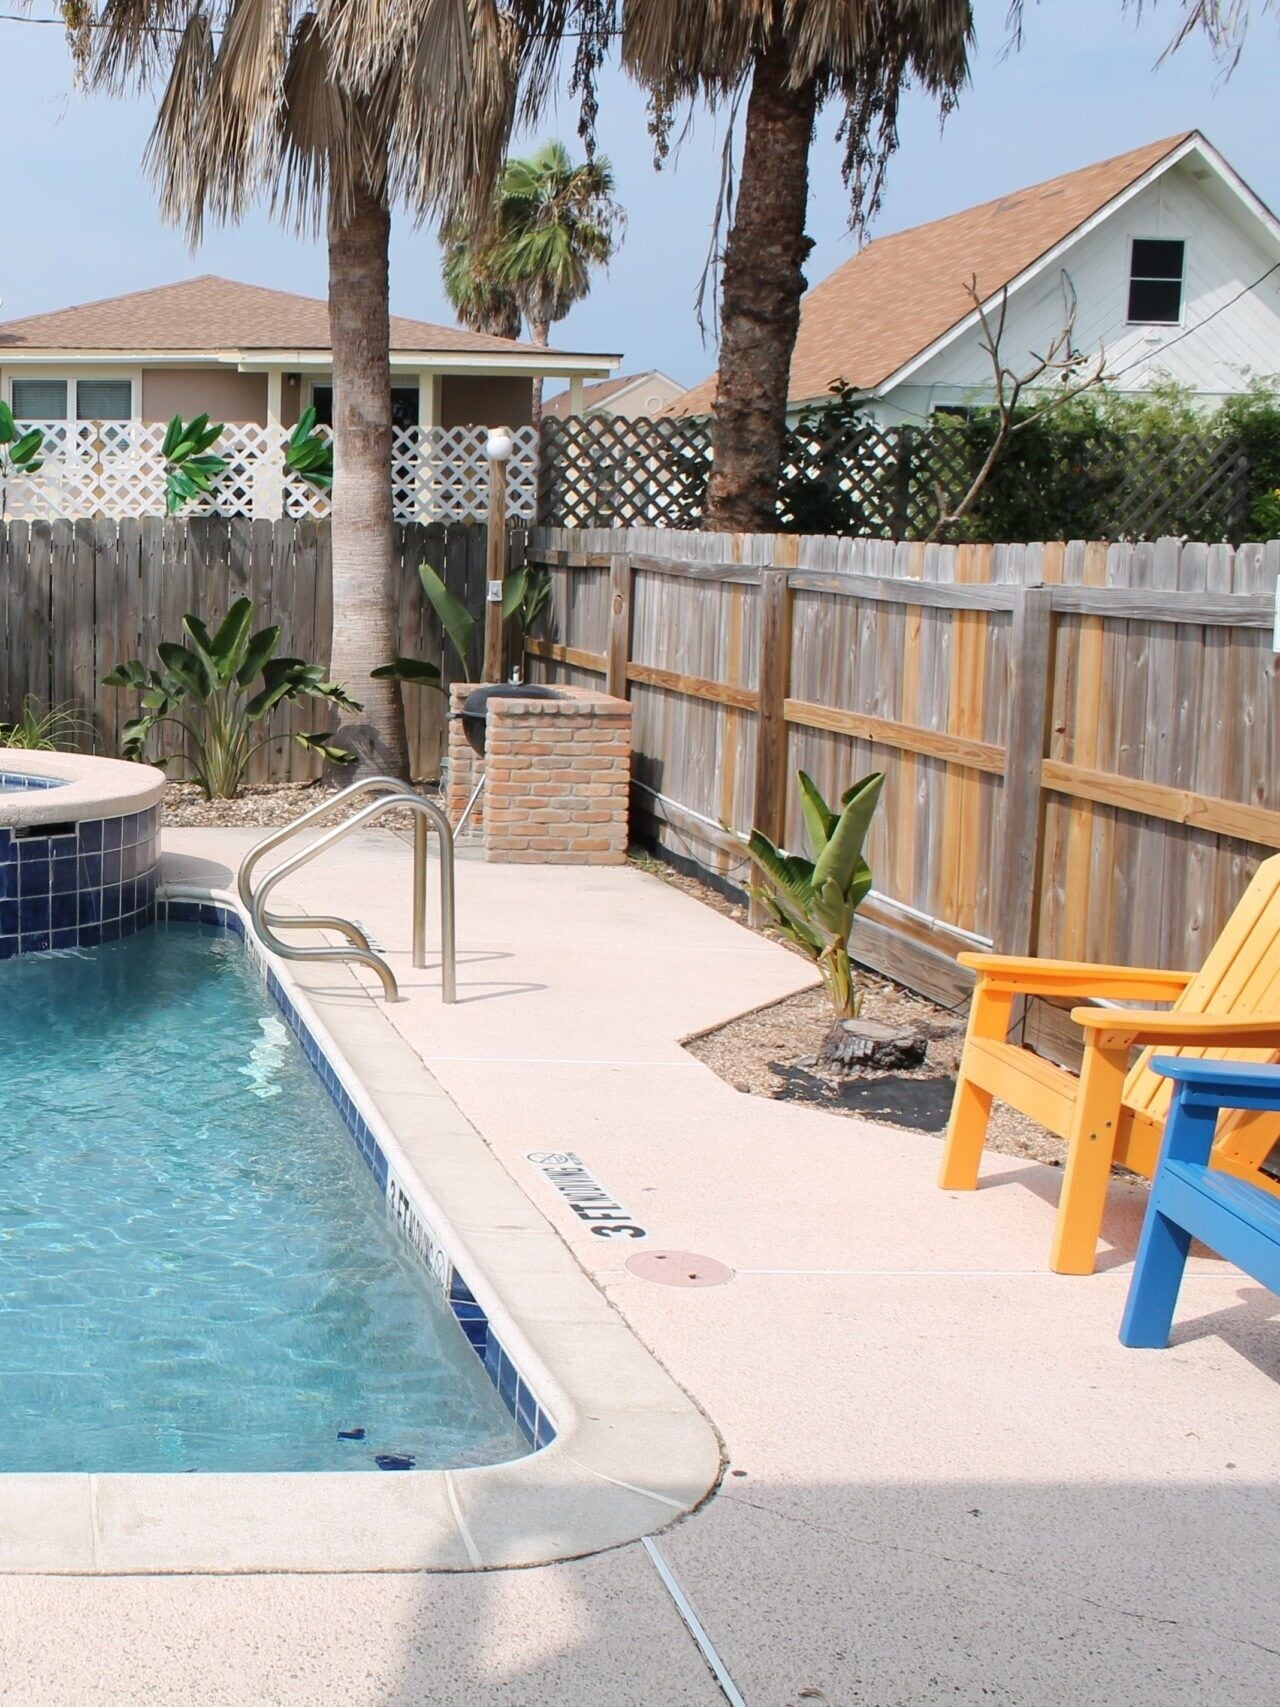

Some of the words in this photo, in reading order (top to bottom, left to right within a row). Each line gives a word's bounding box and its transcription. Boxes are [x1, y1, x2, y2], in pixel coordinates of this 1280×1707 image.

[541, 1167, 602, 1192] DIVING
[562, 1192, 613, 1202] NO
[590, 1225, 646, 1239] 3
